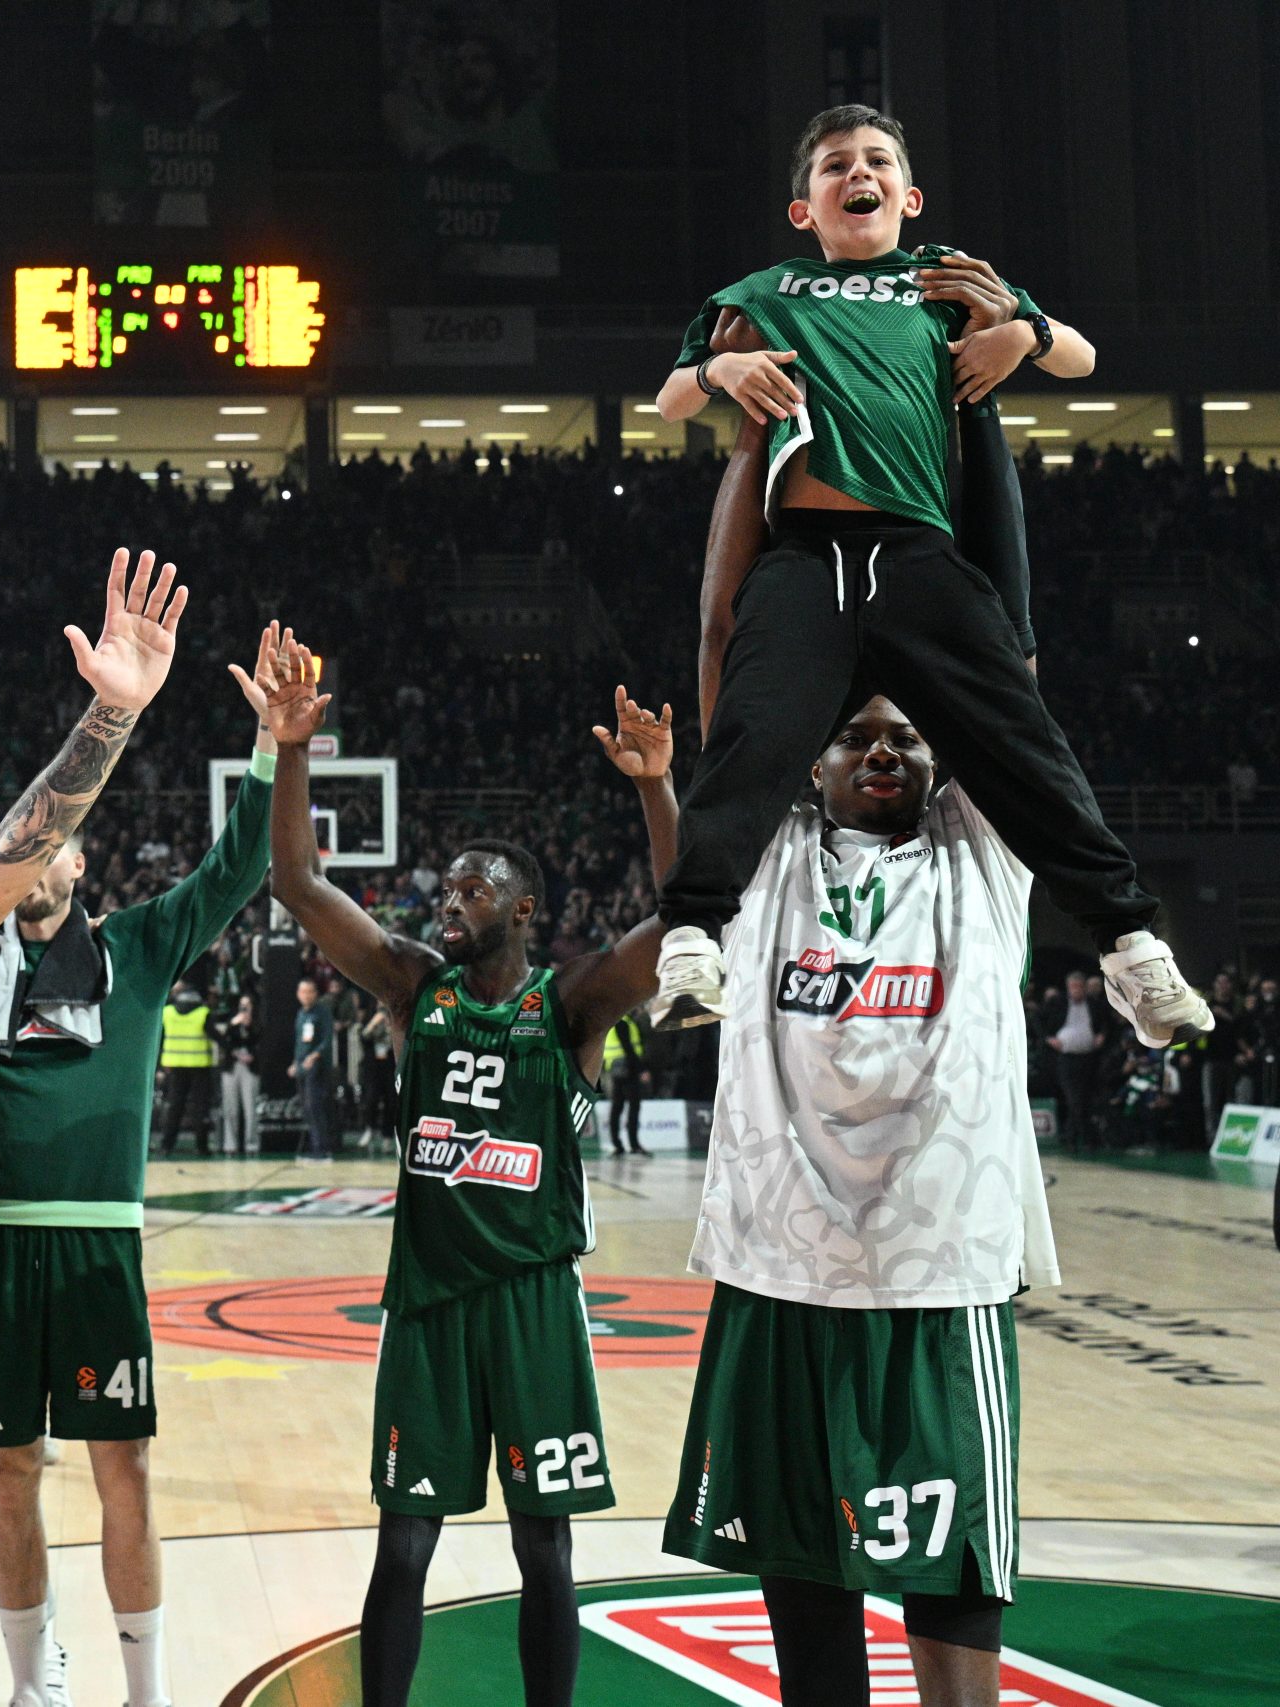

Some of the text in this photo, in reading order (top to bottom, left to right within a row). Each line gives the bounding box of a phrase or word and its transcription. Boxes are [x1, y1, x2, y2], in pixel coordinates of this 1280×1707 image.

[143, 123, 219, 152] Berlin
[148, 159, 215, 186] 2009
[425, 175, 513, 203] Athens
[437, 210, 501, 236] 2007
[883, 847, 932, 865] oneteam
[441, 1050, 505, 1110] 22
[103, 1356, 148, 1409] 41
[383, 1424, 400, 1489] instacar
[534, 1431, 606, 1494] 22
[863, 1478, 957, 1561] 37
